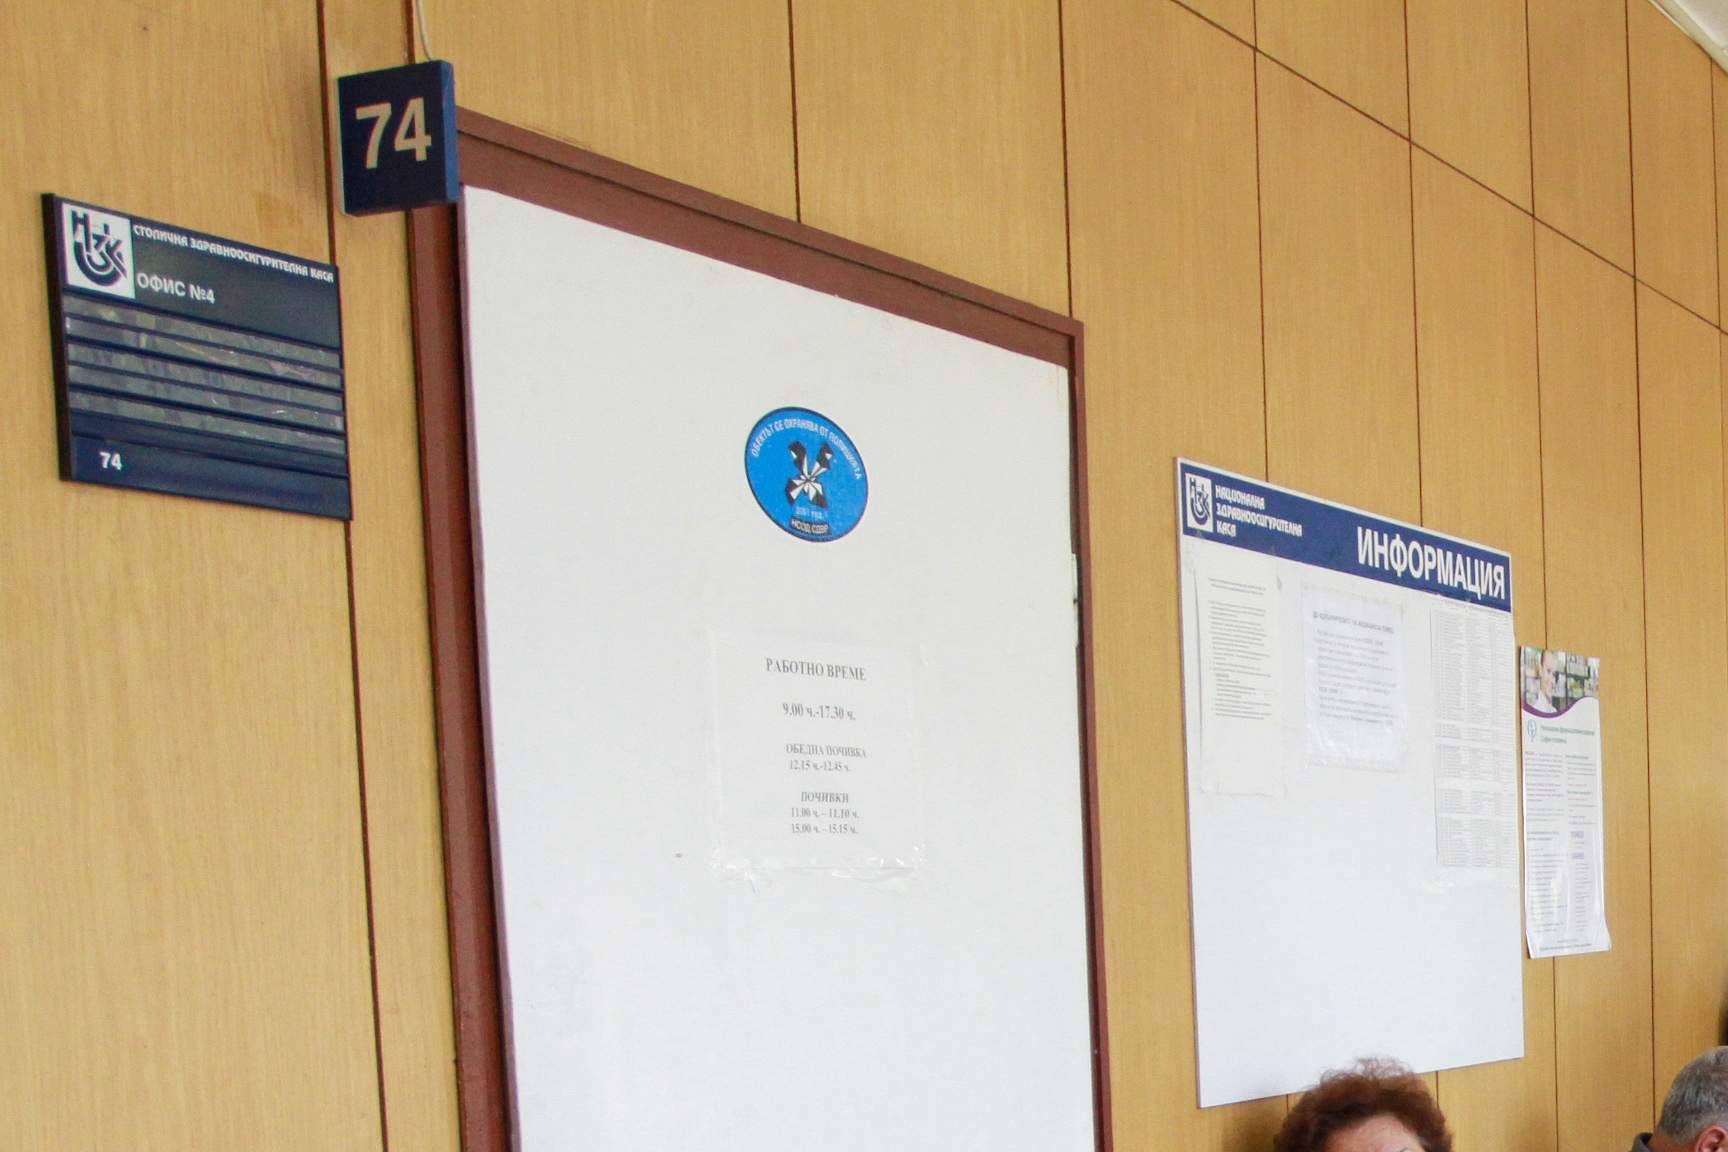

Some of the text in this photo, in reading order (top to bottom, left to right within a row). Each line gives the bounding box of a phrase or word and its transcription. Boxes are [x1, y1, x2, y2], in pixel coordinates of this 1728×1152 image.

[355, 97, 432, 170] 74
[132, 223, 189, 248] СТОЛИЧНА
[136, 272, 216, 305] ОФИС №4
[99, 451, 123, 471] 74
[1356, 525, 1506, 601] ИНФОРМАЦИЯ
[765, 657, 868, 681] РАБОТНО ВРЕМЕ
[782, 702, 805, 718] 9.00
[800, 791, 849, 804] ПОЧИВКИ
